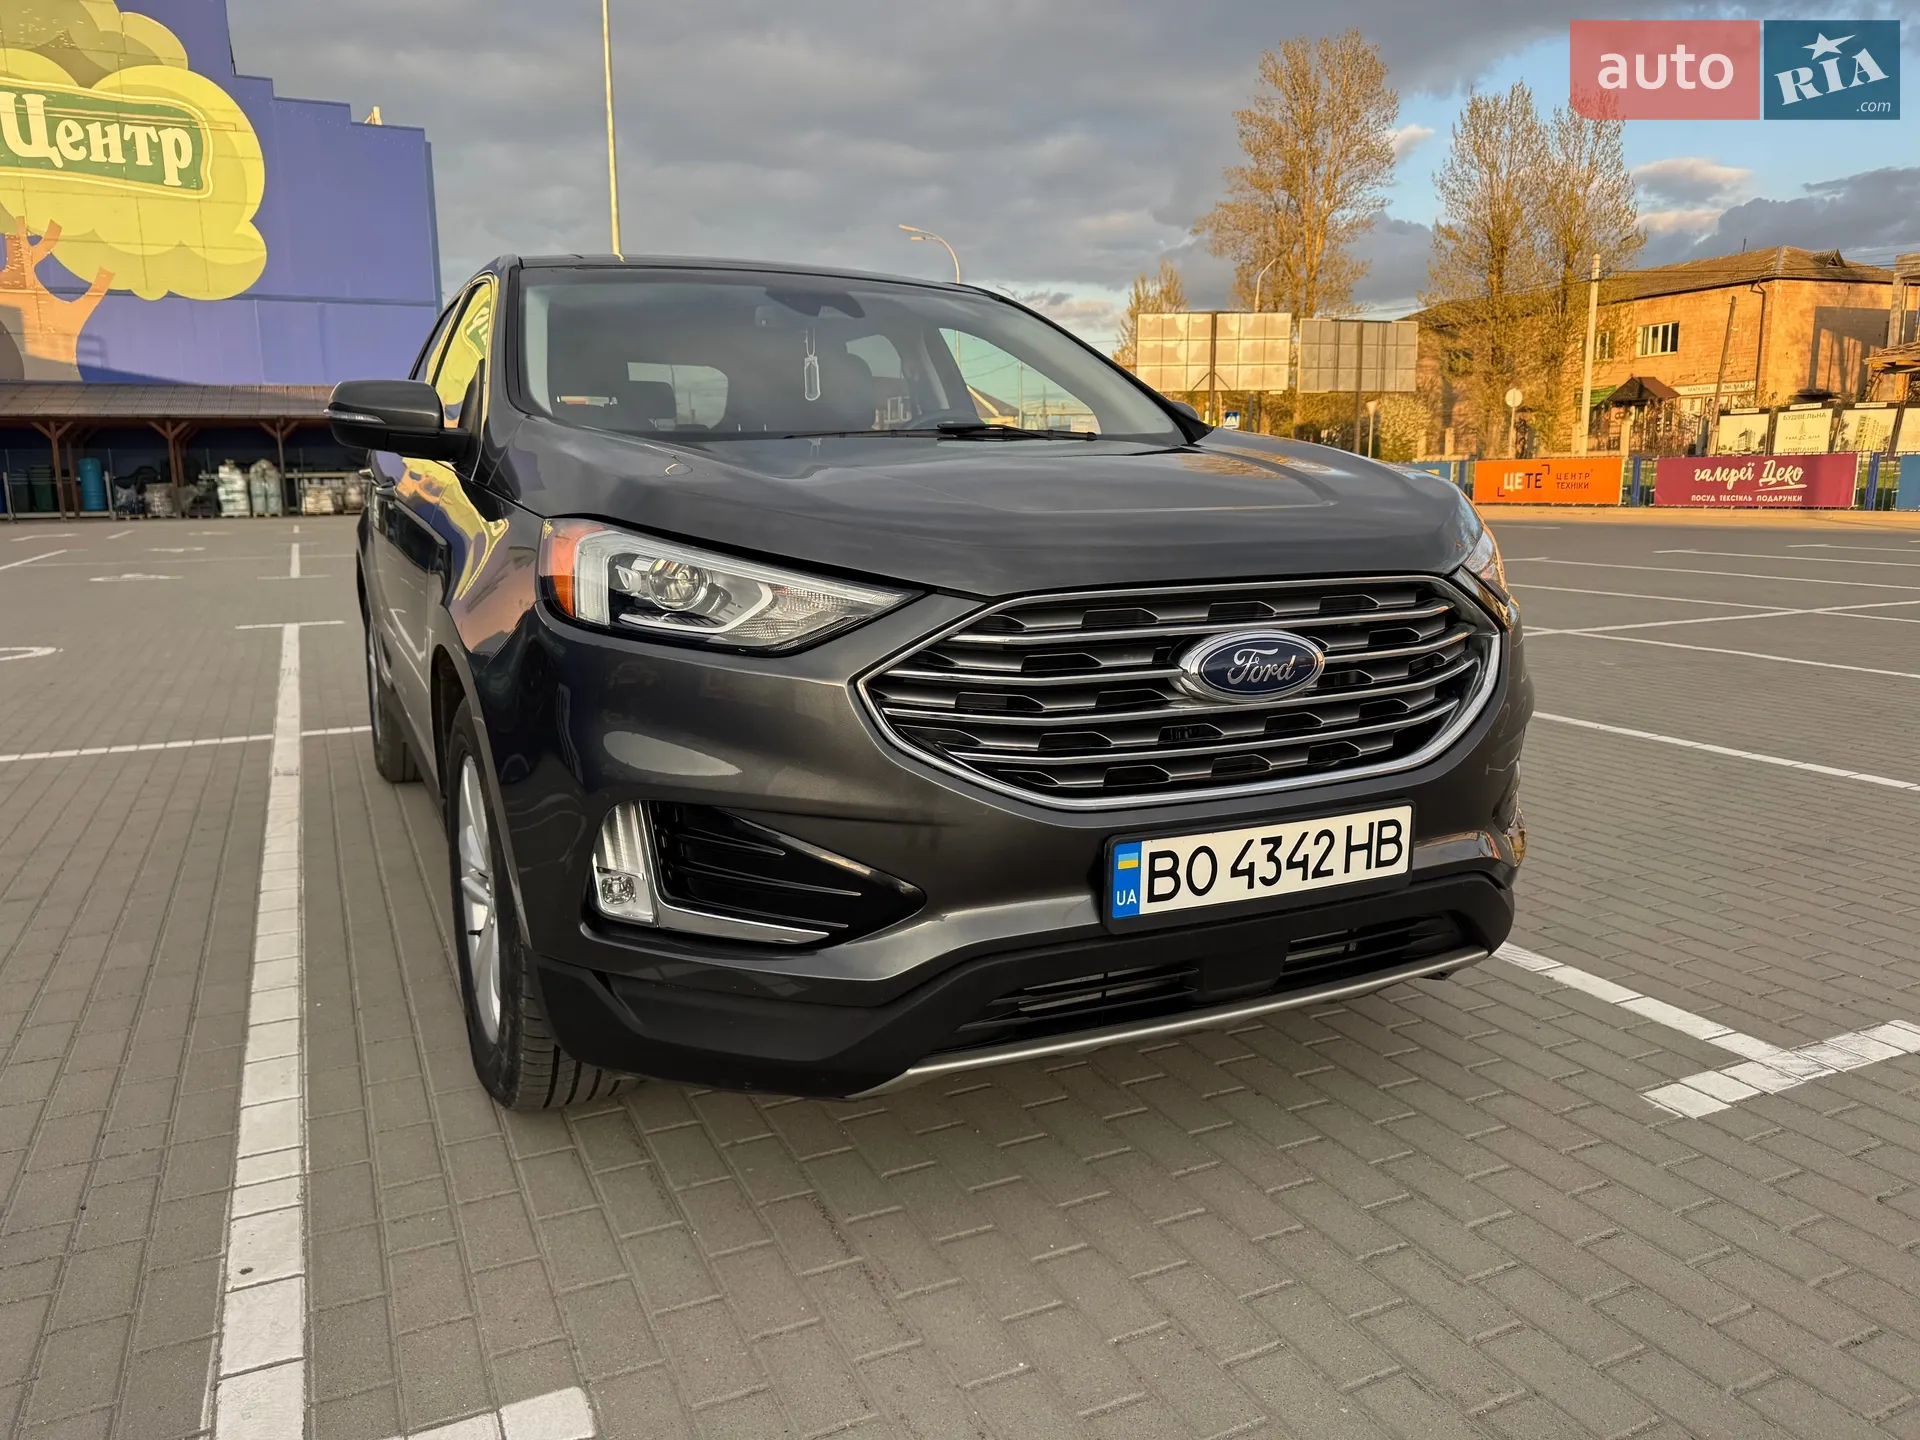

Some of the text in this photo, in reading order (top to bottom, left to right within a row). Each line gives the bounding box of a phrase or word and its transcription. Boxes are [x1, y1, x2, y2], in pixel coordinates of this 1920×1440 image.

[0, 91, 193, 187] Центр
[1503, 472, 1542, 492] ЦЕТЕ
[1759, 460, 1804, 486] Деко
[1556, 482, 1589, 490] ТЕХНІКИ
[1691, 494, 1803, 502] ПОСУД ТЕКСТИЛЬ ПОДАРУНКИ
[1227, 648, 1297, 685] Ford
[1116, 889, 1137, 906] UA
